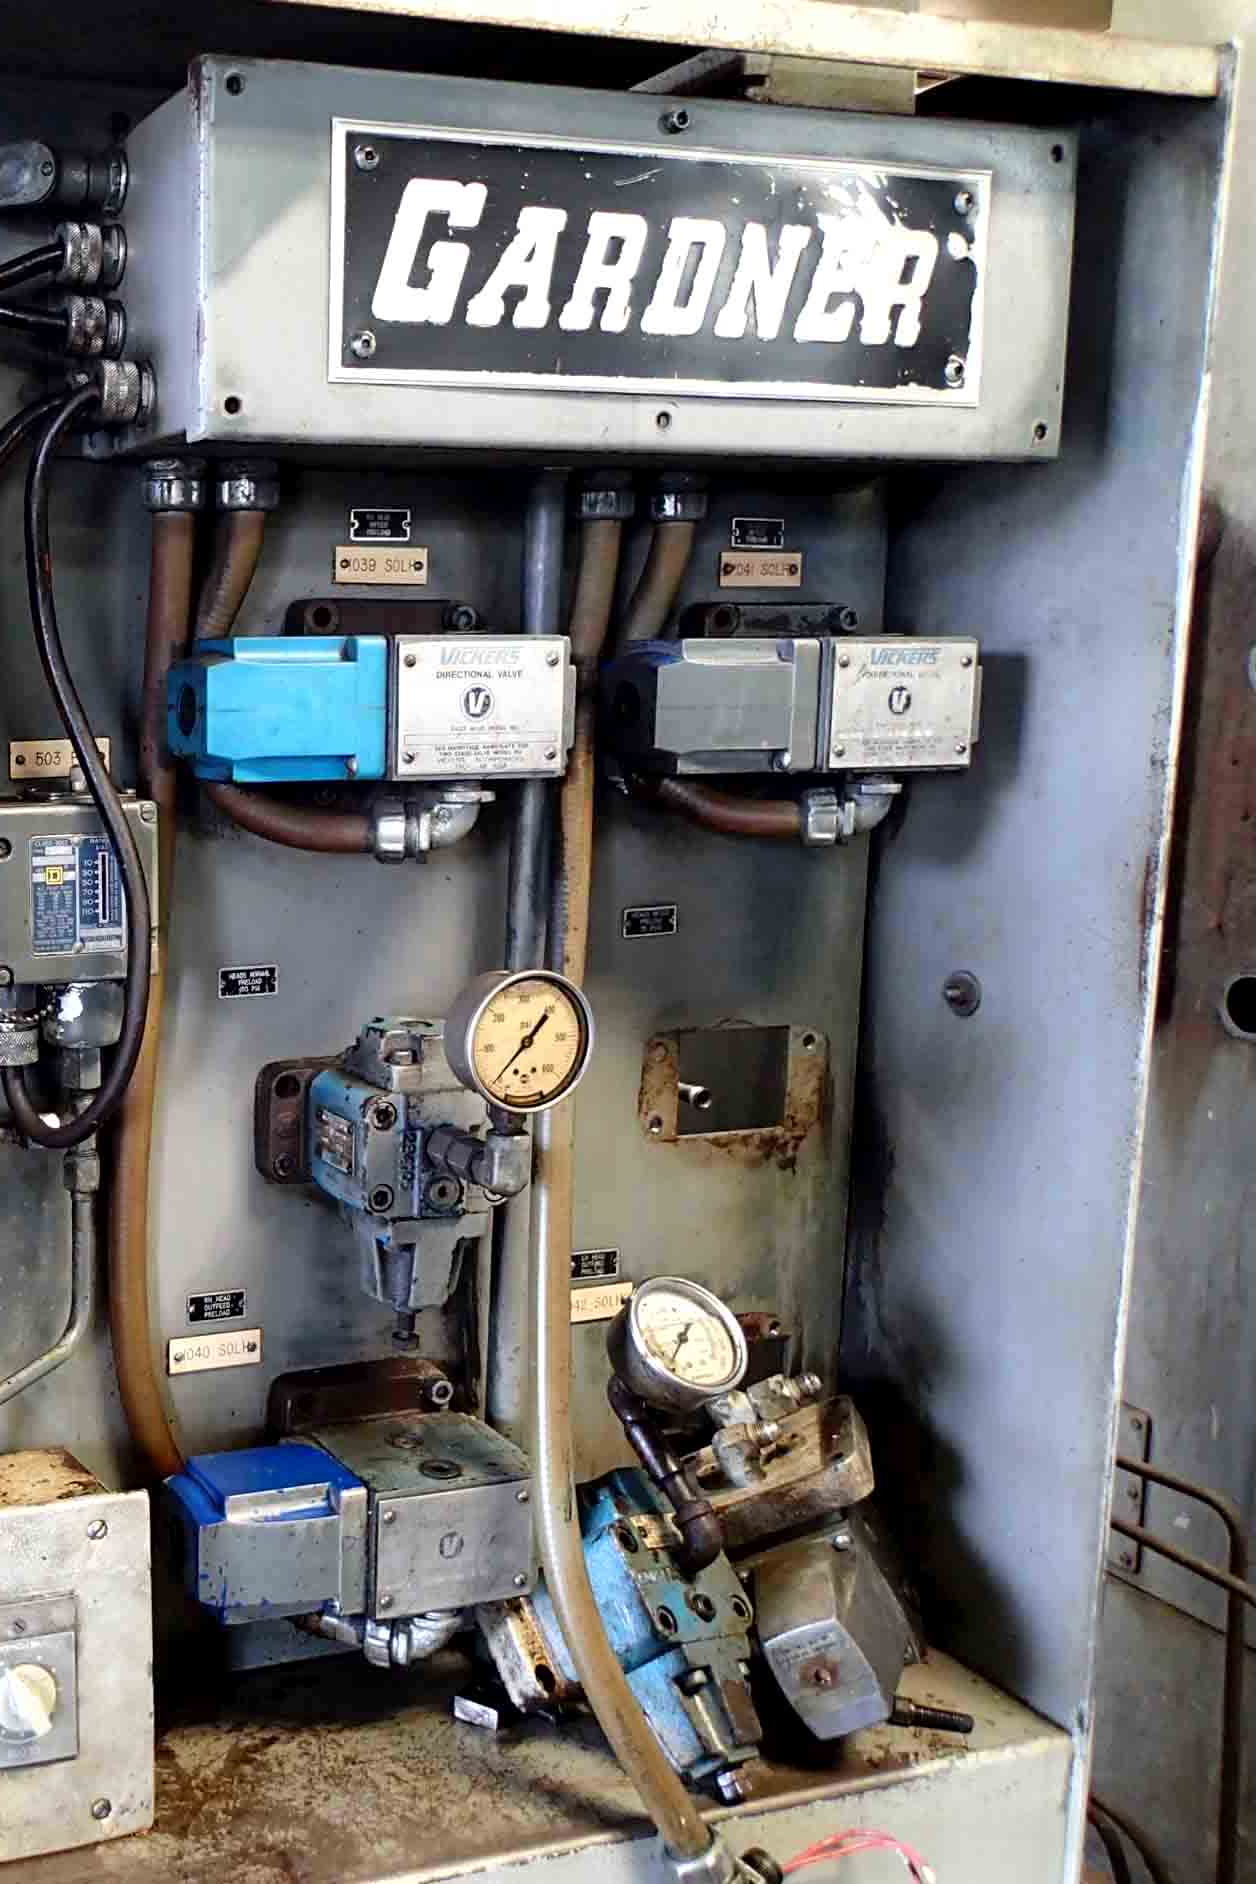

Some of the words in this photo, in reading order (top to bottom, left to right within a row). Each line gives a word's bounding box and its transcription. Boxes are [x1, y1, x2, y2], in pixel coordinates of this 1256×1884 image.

[371, 177, 939, 348] GARDNER
[440, 646, 522, 665] VICKERS
[436, 670, 492, 679] DIRECTIONAL
[497, 670, 524, 679] VALVE
[35, 752, 62, 767] 503
[204, 1301, 231, 1311] OUTFEED
[204, 1308, 231, 1318] PRELOAD
